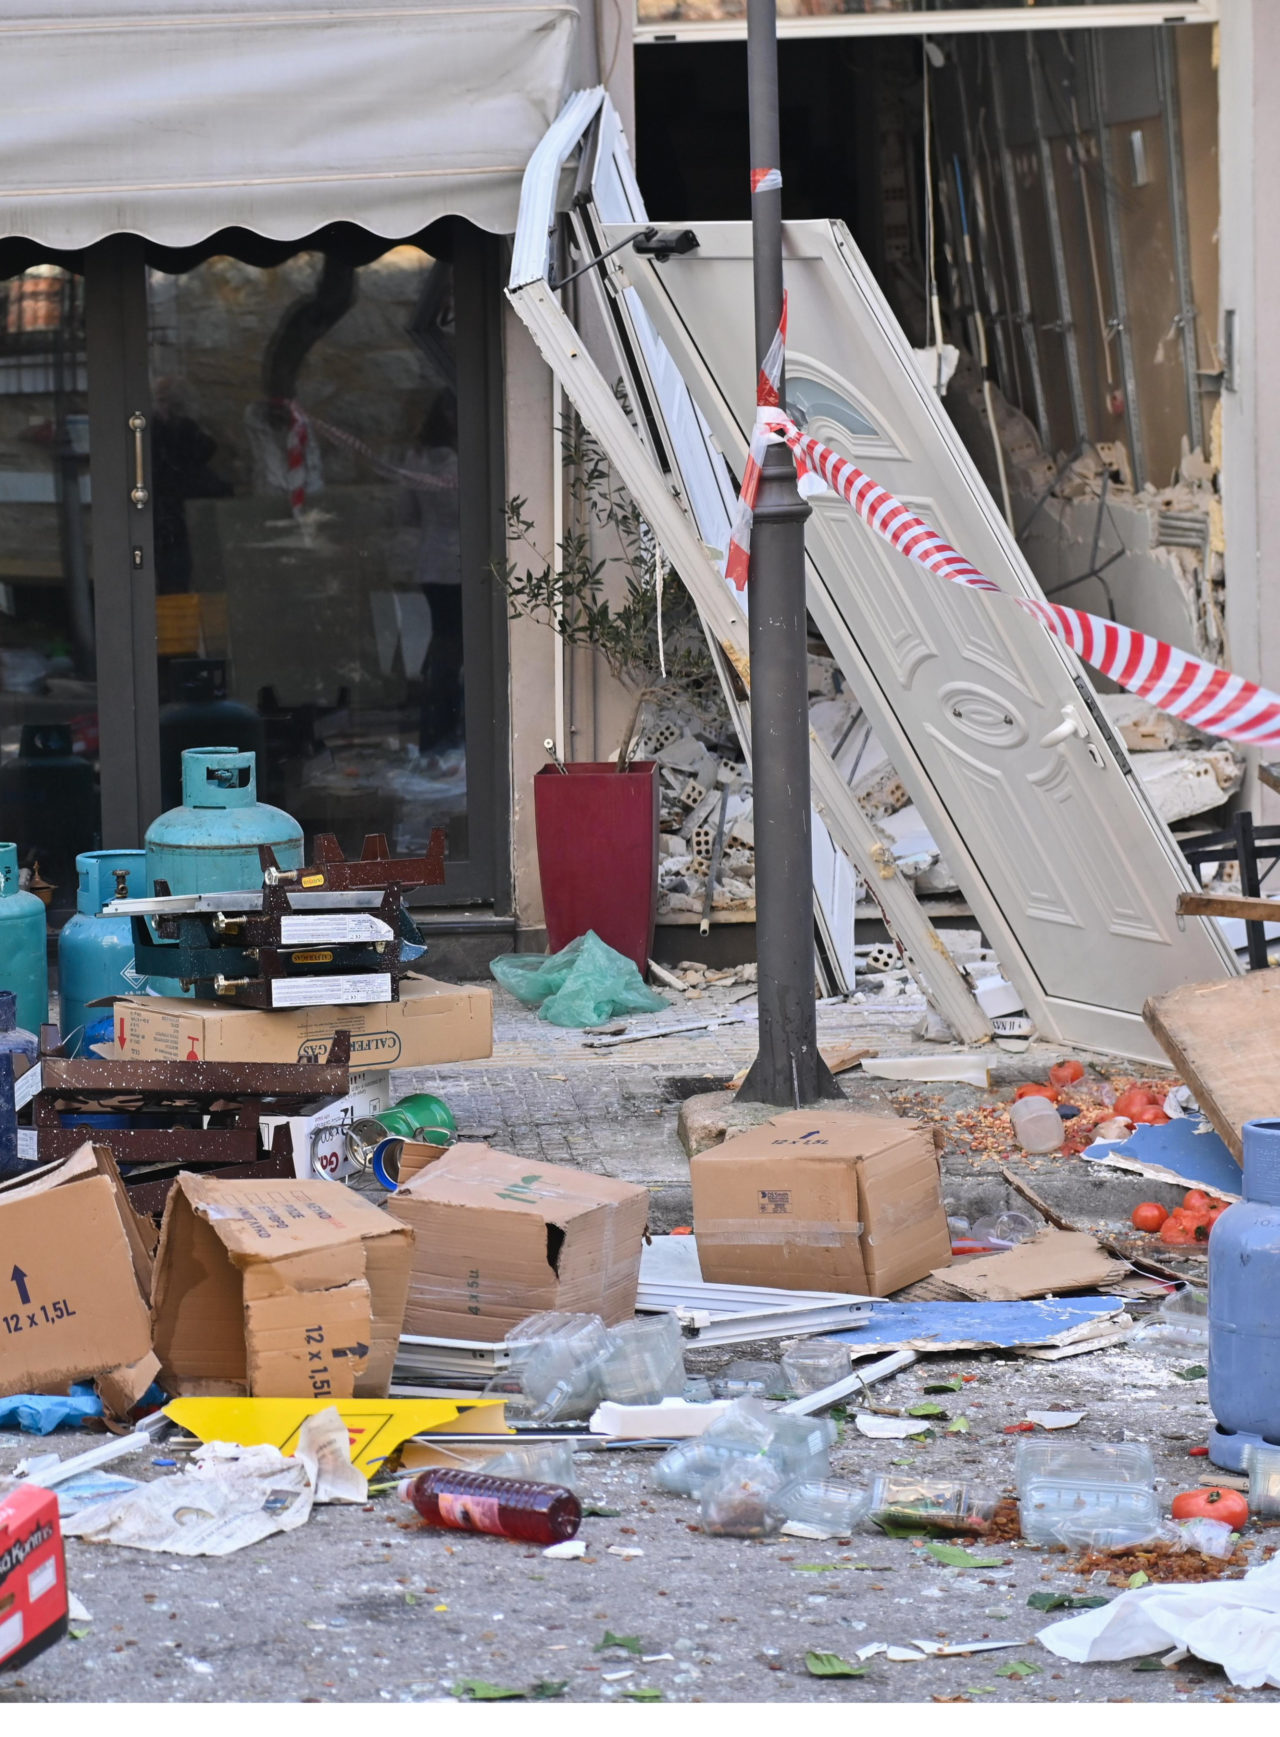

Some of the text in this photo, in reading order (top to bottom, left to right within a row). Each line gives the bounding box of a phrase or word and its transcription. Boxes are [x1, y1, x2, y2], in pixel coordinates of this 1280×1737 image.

[303, 1044, 328, 1056] GAS
[3, 1299, 76, 1334] 12 x 1,5L
[305, 1325, 324, 1344] 12
[308, 1351, 322, 1361] x
